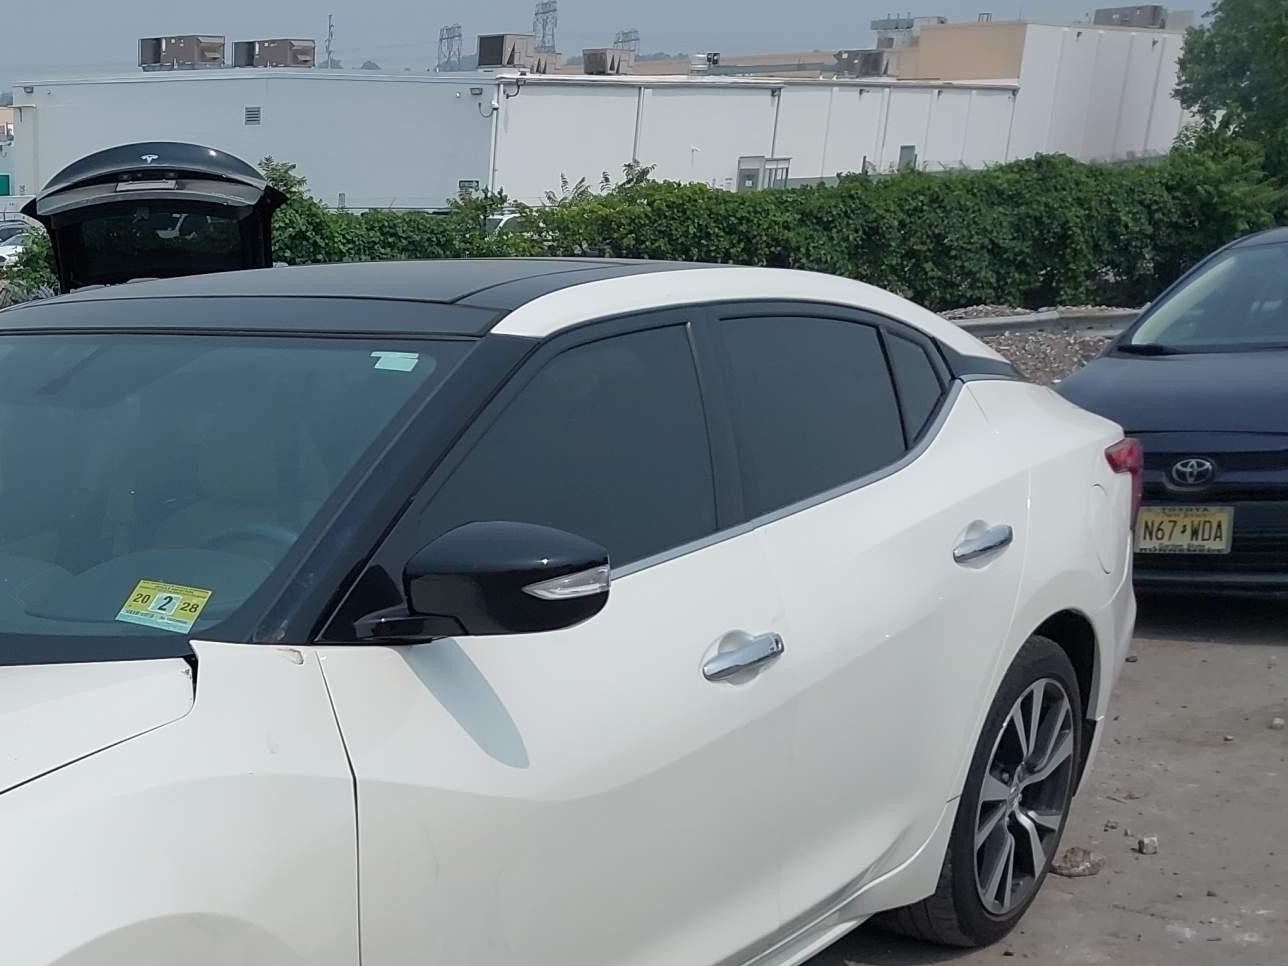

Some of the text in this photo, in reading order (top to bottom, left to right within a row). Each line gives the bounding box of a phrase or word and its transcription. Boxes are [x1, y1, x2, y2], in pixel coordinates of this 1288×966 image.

[1143, 520, 1223, 541] N67 WDA
[133, 593, 200, 613] 20 2 28
